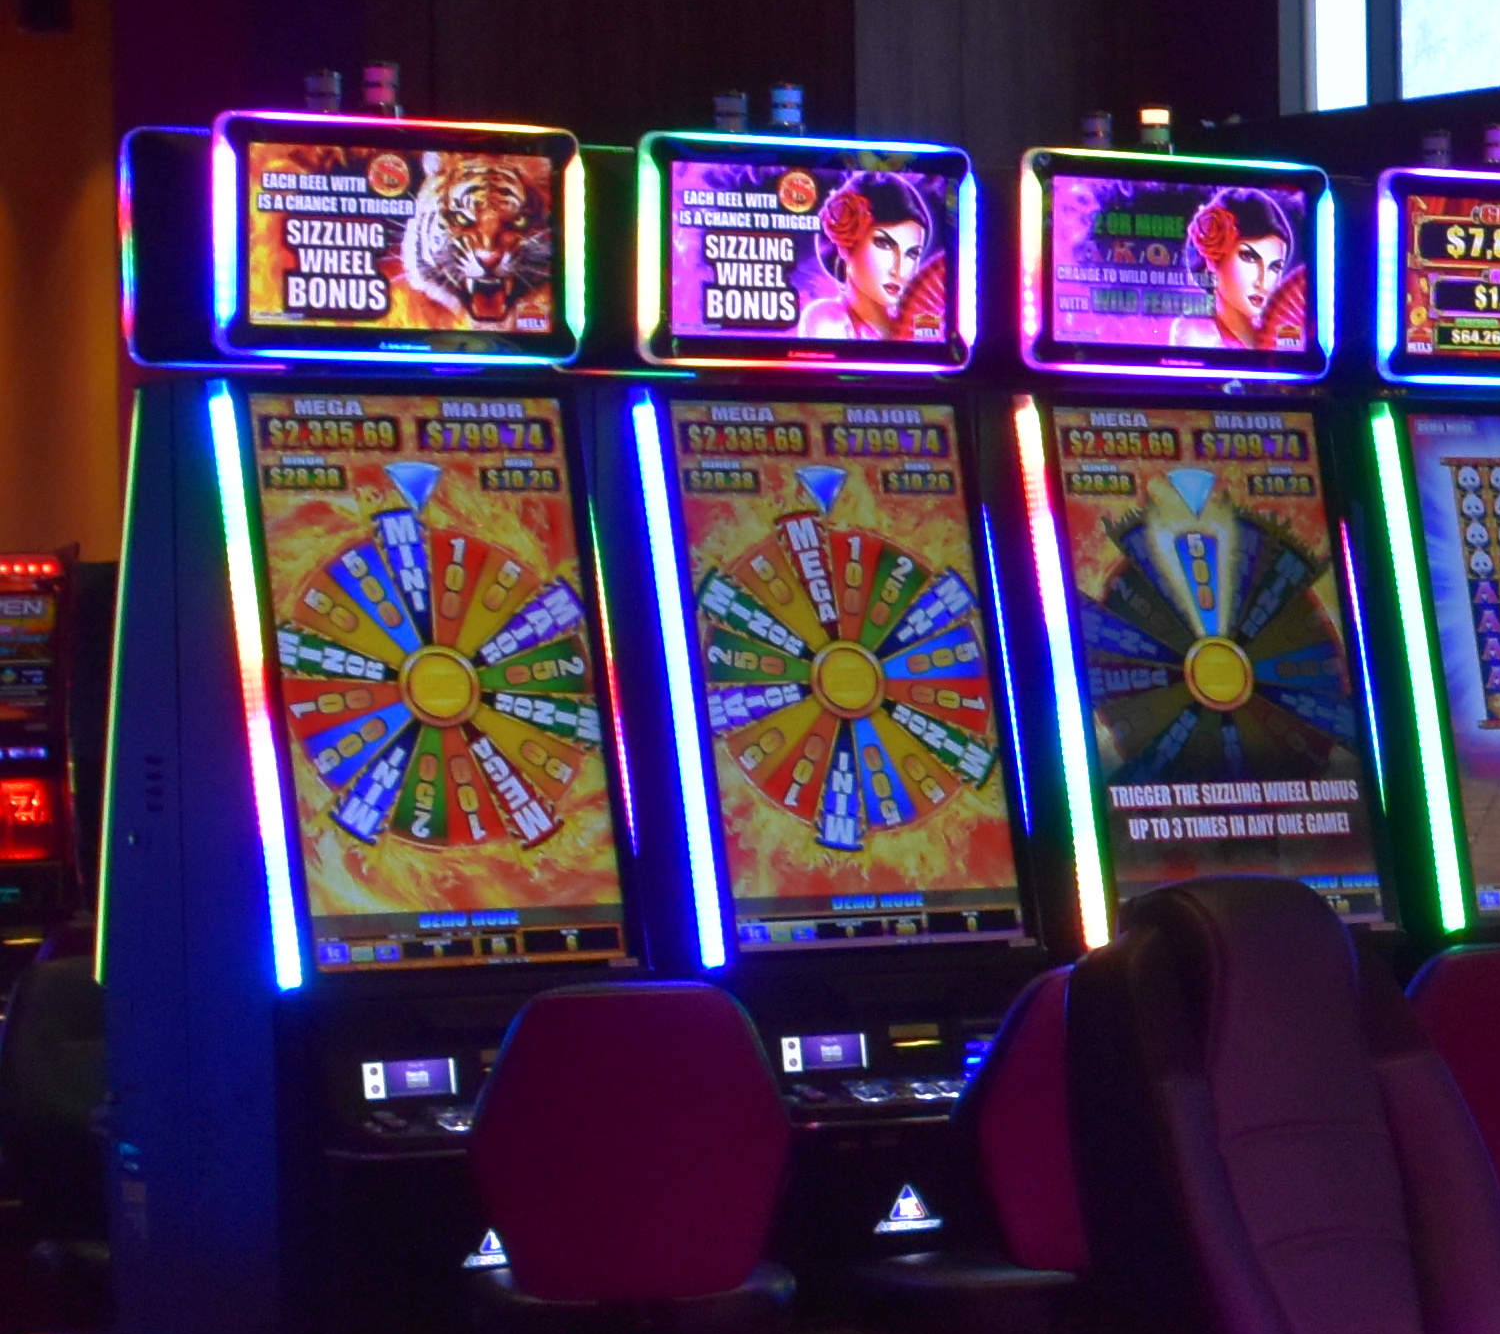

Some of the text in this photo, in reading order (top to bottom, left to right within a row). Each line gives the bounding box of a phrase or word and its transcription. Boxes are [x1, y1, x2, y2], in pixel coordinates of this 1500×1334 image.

[263, 173, 366, 193] EACH REEL WITH
[258, 193, 414, 216] IS A CHANCE TO TRIGGER
[684, 190, 777, 210] EACH REEL WITH
[287, 219, 384, 249] SIZZLING
[680, 212, 820, 231] IS A CHANCE TO TRIGGER
[706, 235, 794, 262] SIZZLING
[298, 248, 375, 276] WHEEL
[716, 263, 785, 289] WHEEL
[1057, 266, 1184, 285] CHANGE TO WILD ON ALL
[287, 276, 388, 310] BONUS
[707, 289, 796, 321] BONUS
[1059, 288, 1215, 316] WITH WILD FEATURE
[295, 399, 524, 419] MEGA MAJOR
[711, 406, 922, 424] MEGA MAJOR
[1090, 412, 1283, 430] MEGA MAJOR
[426, 421, 545, 449] $799.74
[833, 428, 940, 454] $799.74
[1110, 780, 1358, 808] TRIGGER THE SIZZLING WHEEL BONUS
[1129, 812, 1350, 840] UP TO 3 TIMES IN ANY ONE GAME!
[419, 911, 519, 928] DEMO MODE
